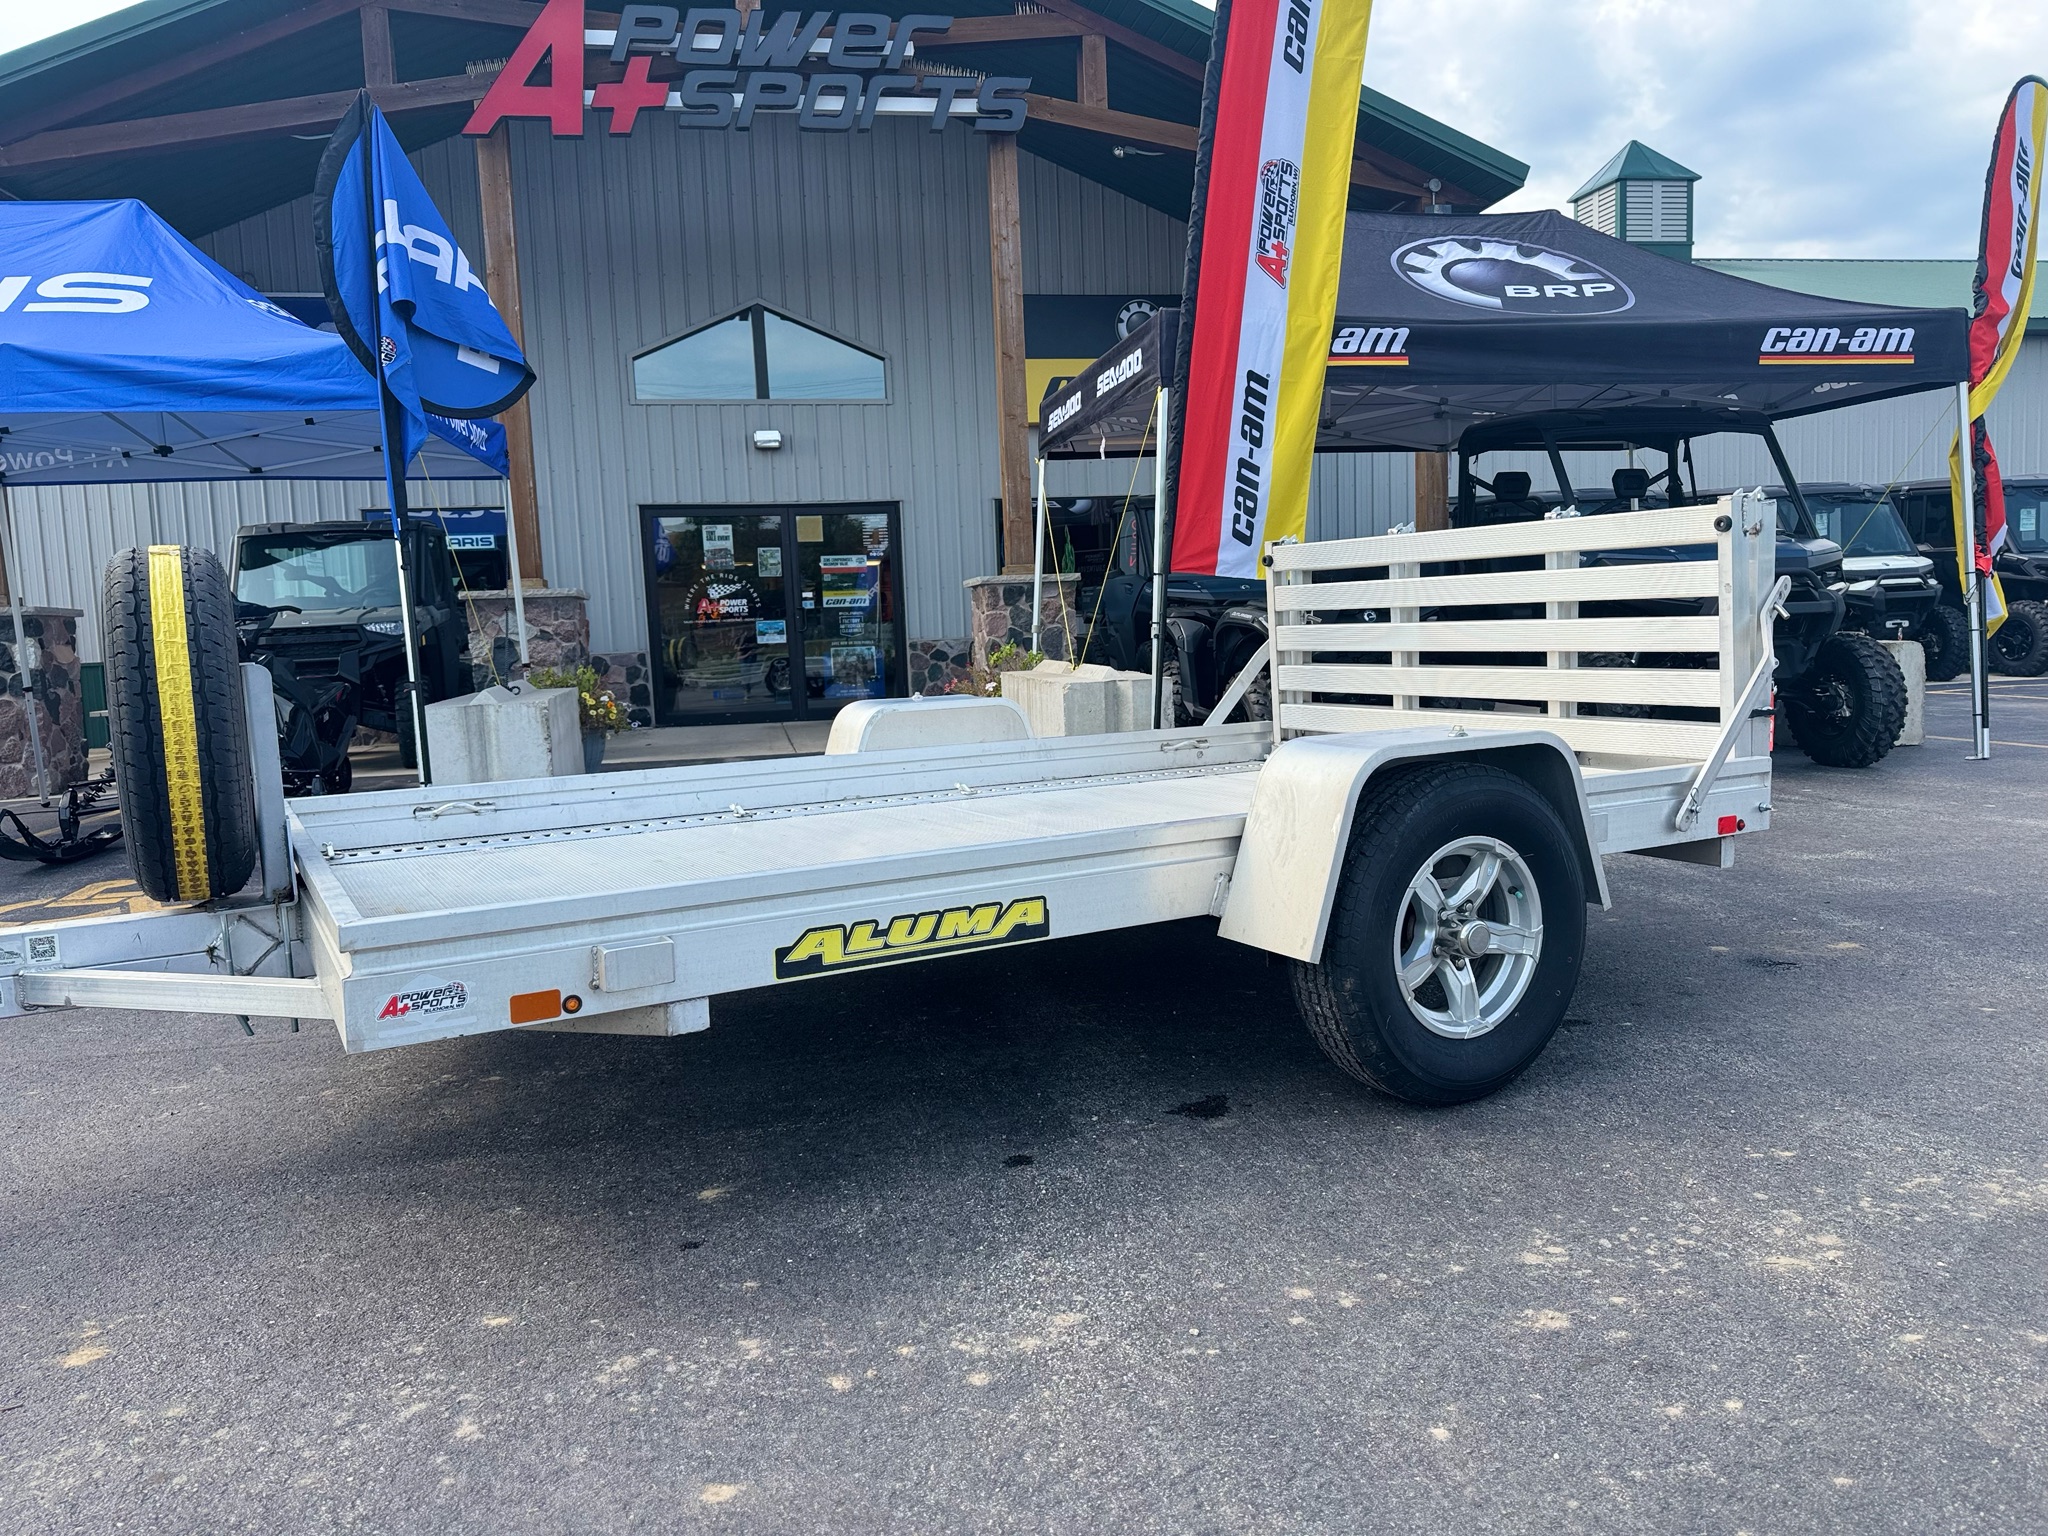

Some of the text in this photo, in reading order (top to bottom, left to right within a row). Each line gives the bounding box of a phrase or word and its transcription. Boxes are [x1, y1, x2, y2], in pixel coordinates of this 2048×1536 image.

[461, 0, 669, 138] A+
[1257, 240, 1288, 286] A+
[1504, 282, 1616, 298] BRP
[1760, 327, 1915, 353] can-am
[1231, 369, 1271, 546] can-am
[684, 572, 761, 610] WHERE THE RIDE STARTS
[720, 598, 747, 606] POWER
[825, 598, 867, 606] can-am
[719, 605, 748, 613] SPORTS
[783, 898, 1045, 966] ALUMA
[379, 995, 411, 1019] A+
